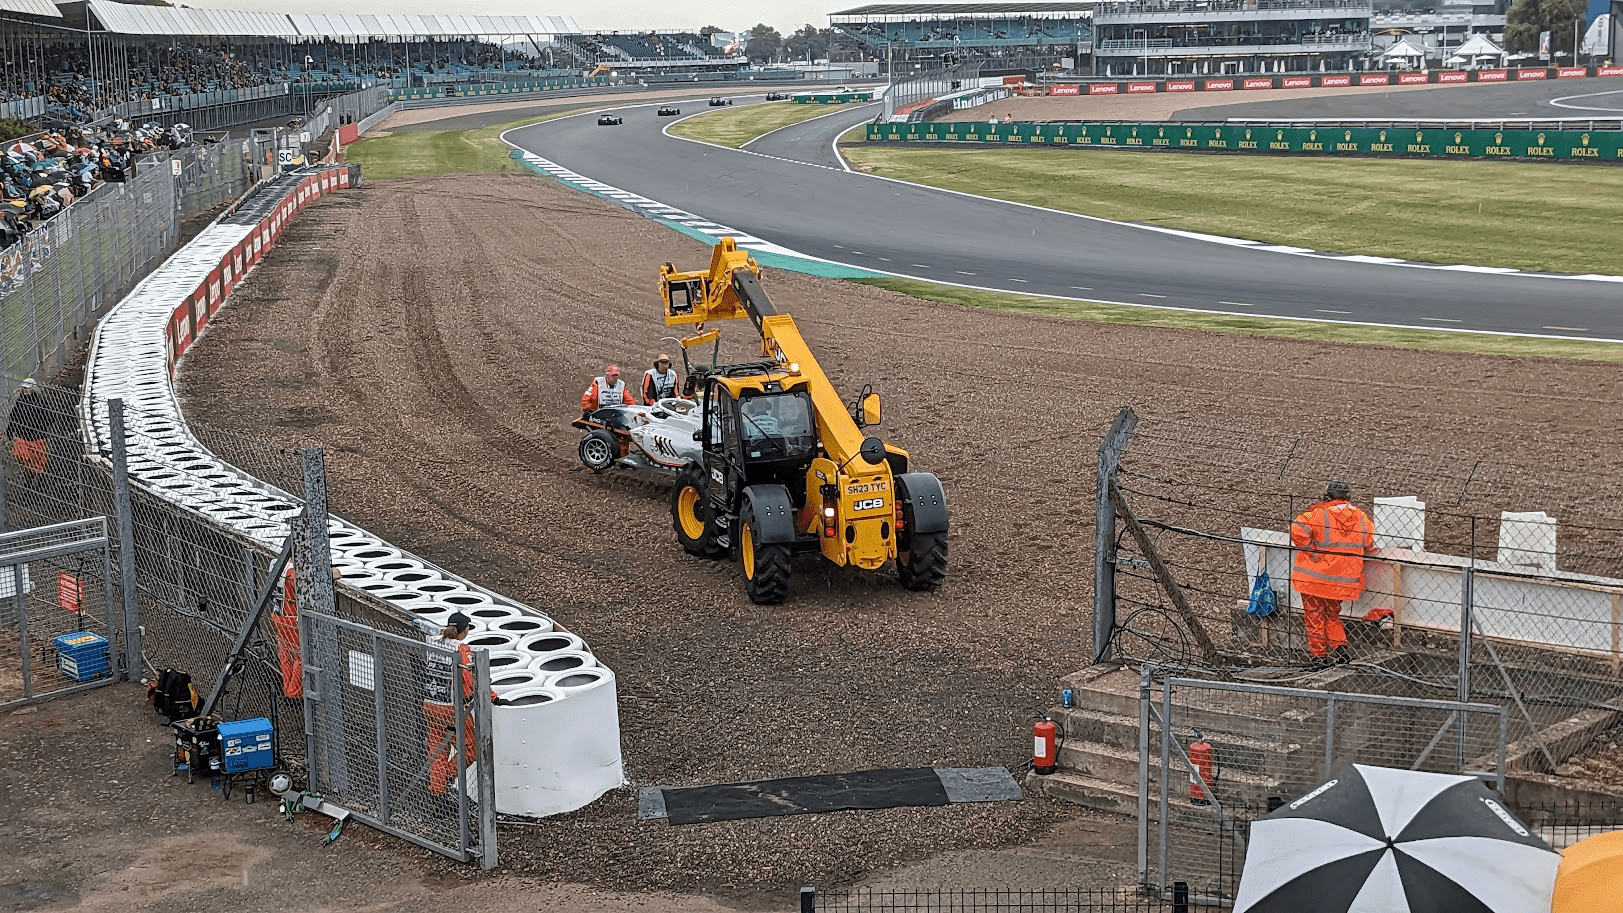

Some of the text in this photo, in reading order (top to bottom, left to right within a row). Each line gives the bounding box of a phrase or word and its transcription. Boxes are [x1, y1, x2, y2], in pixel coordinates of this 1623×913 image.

[1077, 136, 1091, 144] ROLEX
[1408, 145, 1430, 153] ROLEX
[1446, 146, 1469, 154] ROLEX
[1486, 146, 1510, 155] ROLEX
[1528, 147, 1554, 156] ROLEX
[1571, 148, 1599, 156] ROLEX
[280, 152, 292, 162] SC
[848, 482, 886, 494] SH23 TYC
[854, 498, 884, 511] JCB
